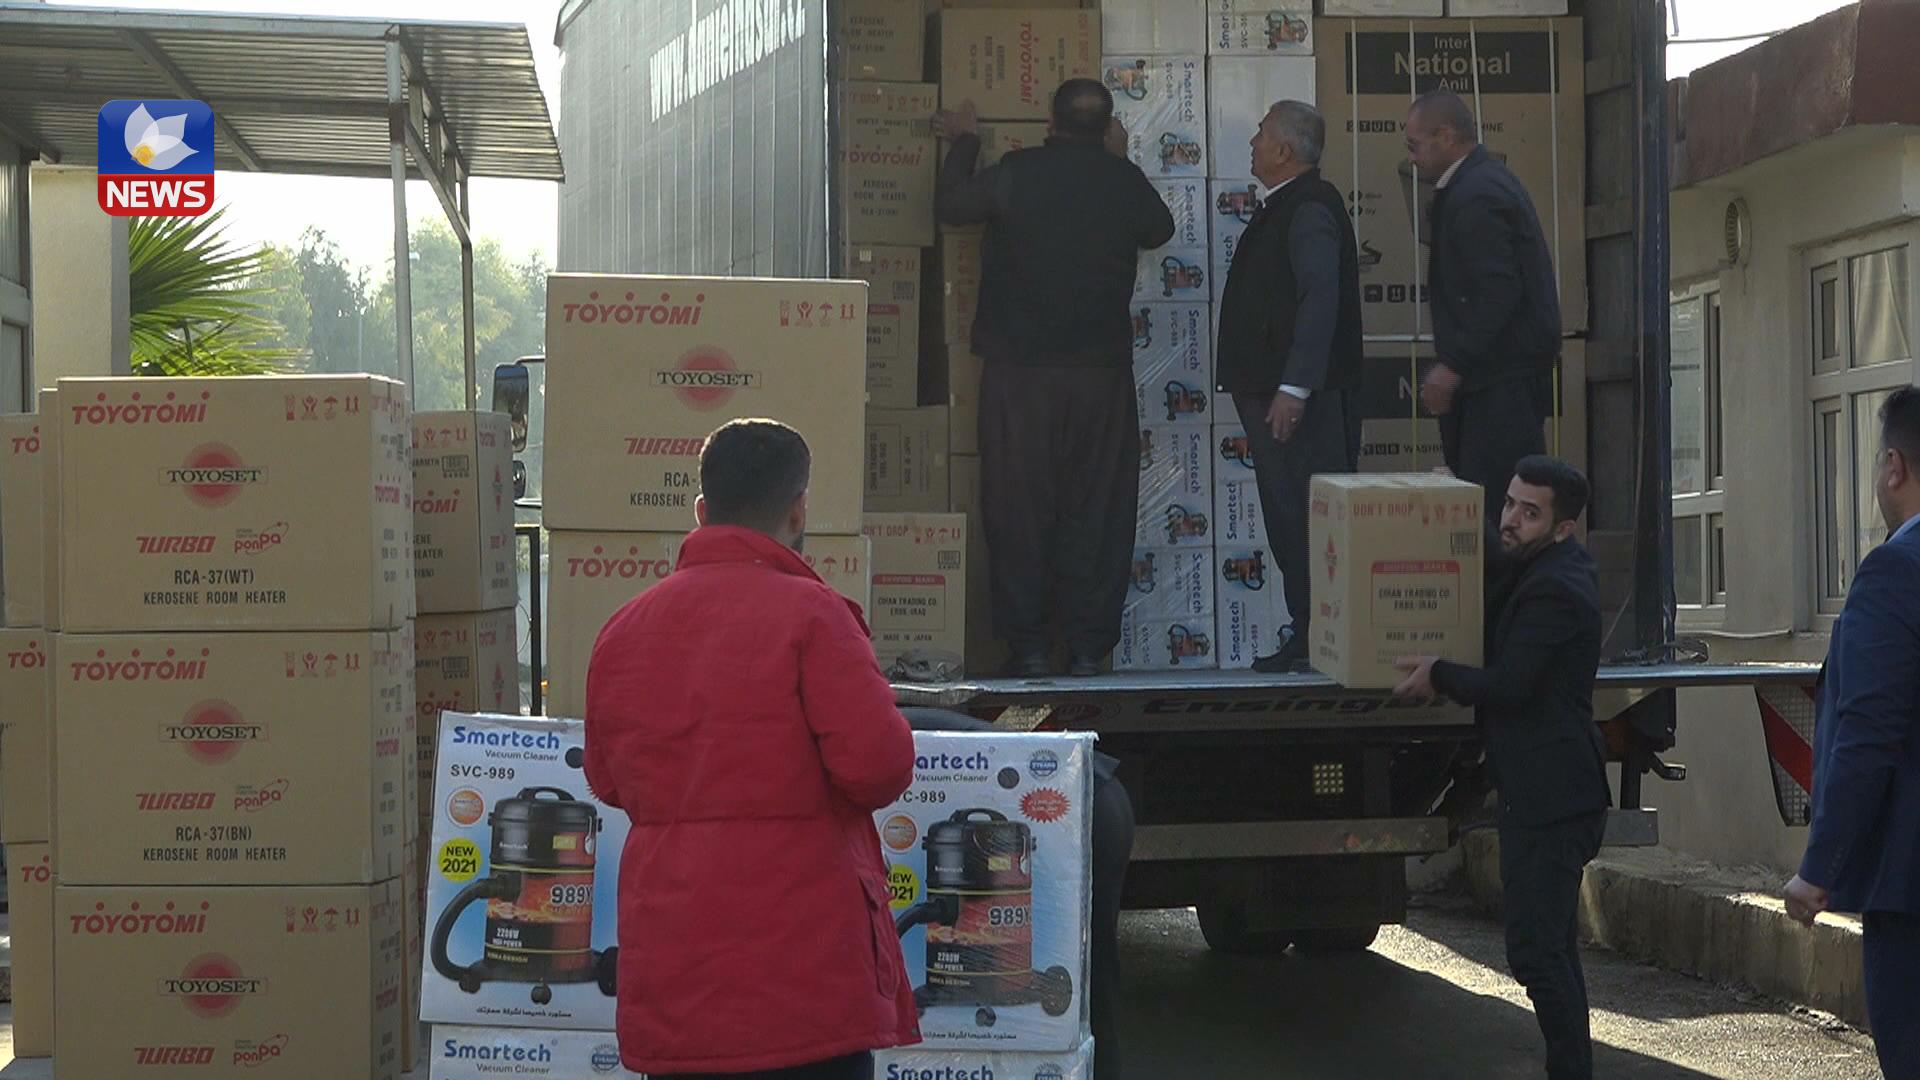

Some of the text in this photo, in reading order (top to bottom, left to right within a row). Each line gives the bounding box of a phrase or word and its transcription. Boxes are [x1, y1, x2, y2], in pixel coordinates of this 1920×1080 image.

[1434, 36, 1470, 50] Inter
[1393, 51, 1512, 76] National
[1438, 77, 1469, 91] Anil
[840, 144, 923, 167] TOYOTOMI
[563, 292, 706, 326] TOYOTOMI
[657, 371, 754, 386] TOYOSET
[71, 392, 210, 425] TOYOTOMI
[166, 469, 262, 484] TOYOSET
[630, 493, 687, 507] KEROSENE
[1227, 480, 1238, 540] Smartech
[886, 525, 909, 537] DROP
[136, 535, 216, 555] TURBO
[143, 590, 286, 605] KEROSENE ROOM HEATER
[1230, 601, 1241, 662] Smartech
[70, 647, 210, 682] TOYOTOMI
[166, 726, 261, 740] TOYOSET
[452, 725, 560, 750] Smartech
[484, 749, 559, 762] Vacuum Cleaner
[915, 751, 989, 770] artech
[450, 765, 515, 780] SVC-989
[915, 773, 988, 782] Vacuum Cleaner
[136, 792, 216, 811] TURBO
[175, 825, 253, 843] RCA-37(BN)
[143, 847, 287, 862] KEROSENE ROOM HEATER
[446, 846, 475, 857] NEW
[442, 858, 477, 875] 2021
[890, 886, 914, 901] 021
[70, 901, 210, 935] TOYOTOMI
[165, 979, 260, 993] TOYOSET
[134, 1046, 215, 1064] TURBO
[444, 1039, 551, 1062] Smartech
[477, 1062, 551, 1076] Vacuum Cleaner
[887, 1063, 994, 1080] Smartech
